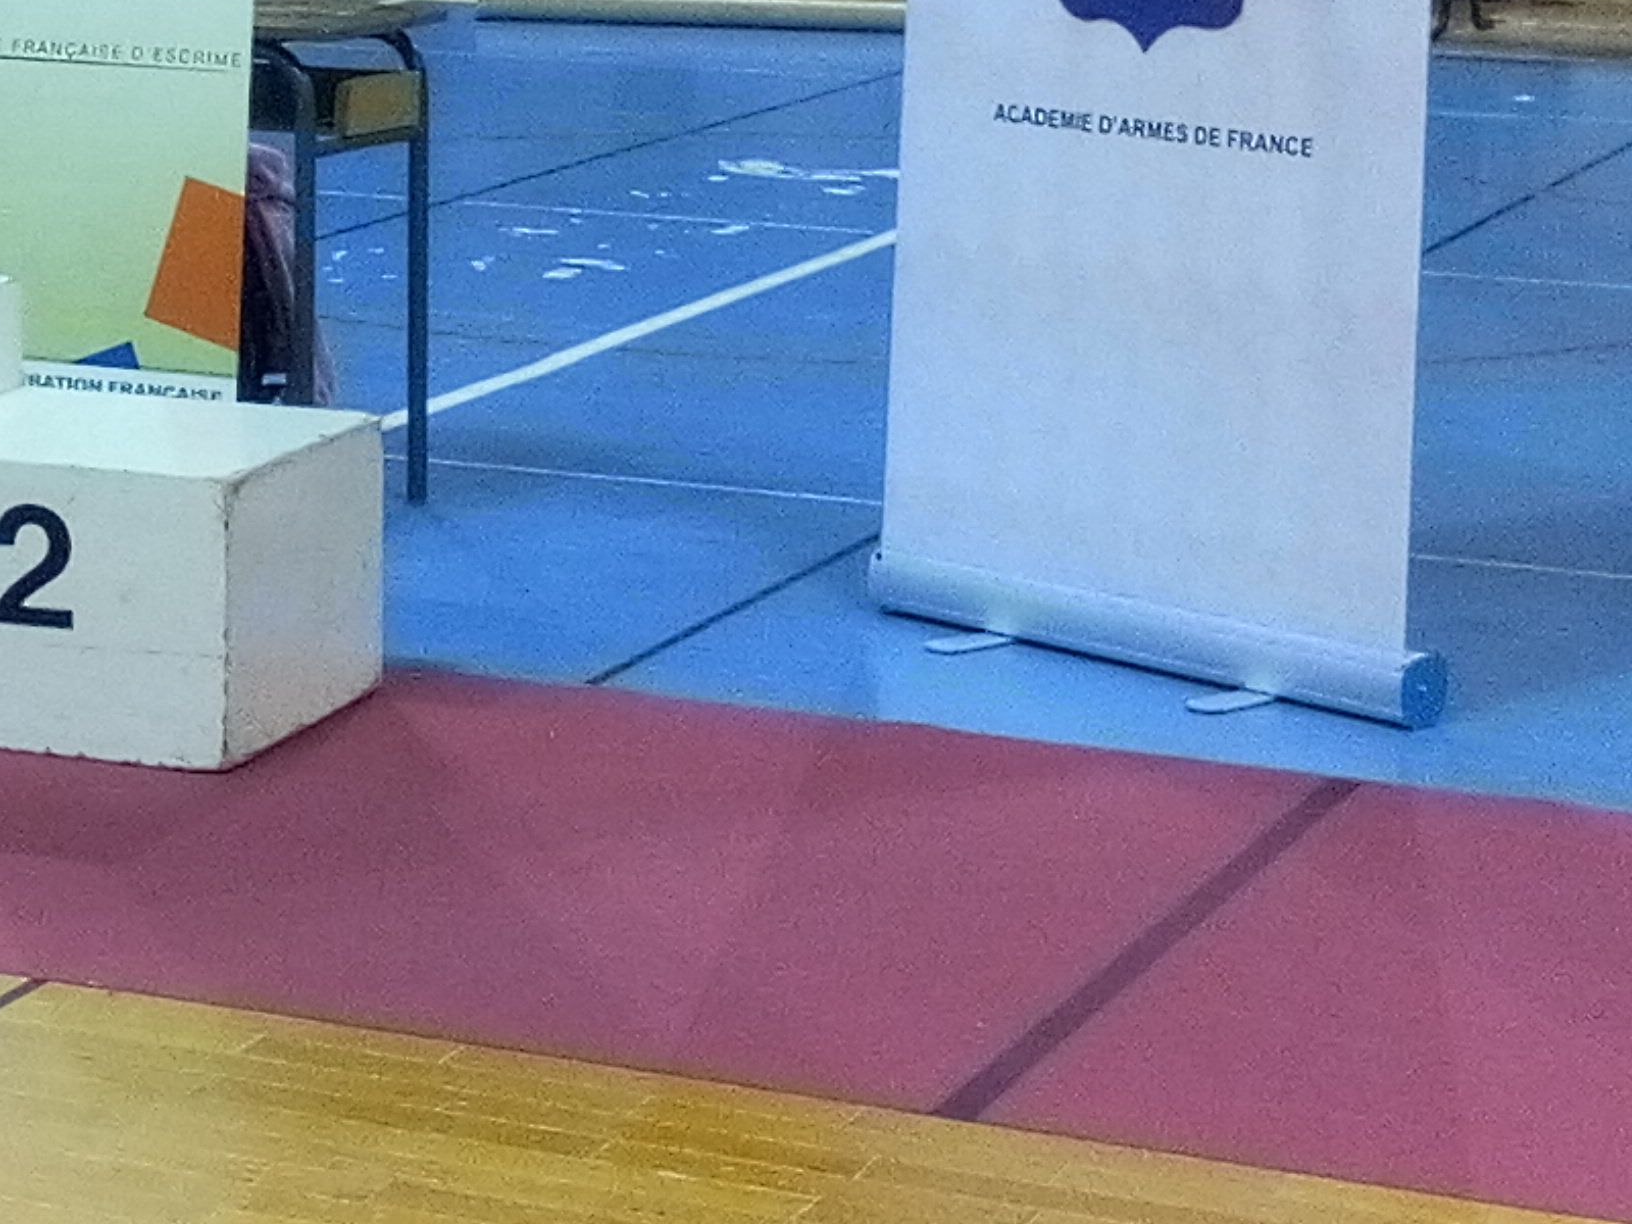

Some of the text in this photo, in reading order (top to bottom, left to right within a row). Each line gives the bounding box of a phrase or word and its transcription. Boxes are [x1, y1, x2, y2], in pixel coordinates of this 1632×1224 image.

[993, 102, 1314, 159] ACADEMIE D'ARMES DE FRANCE
